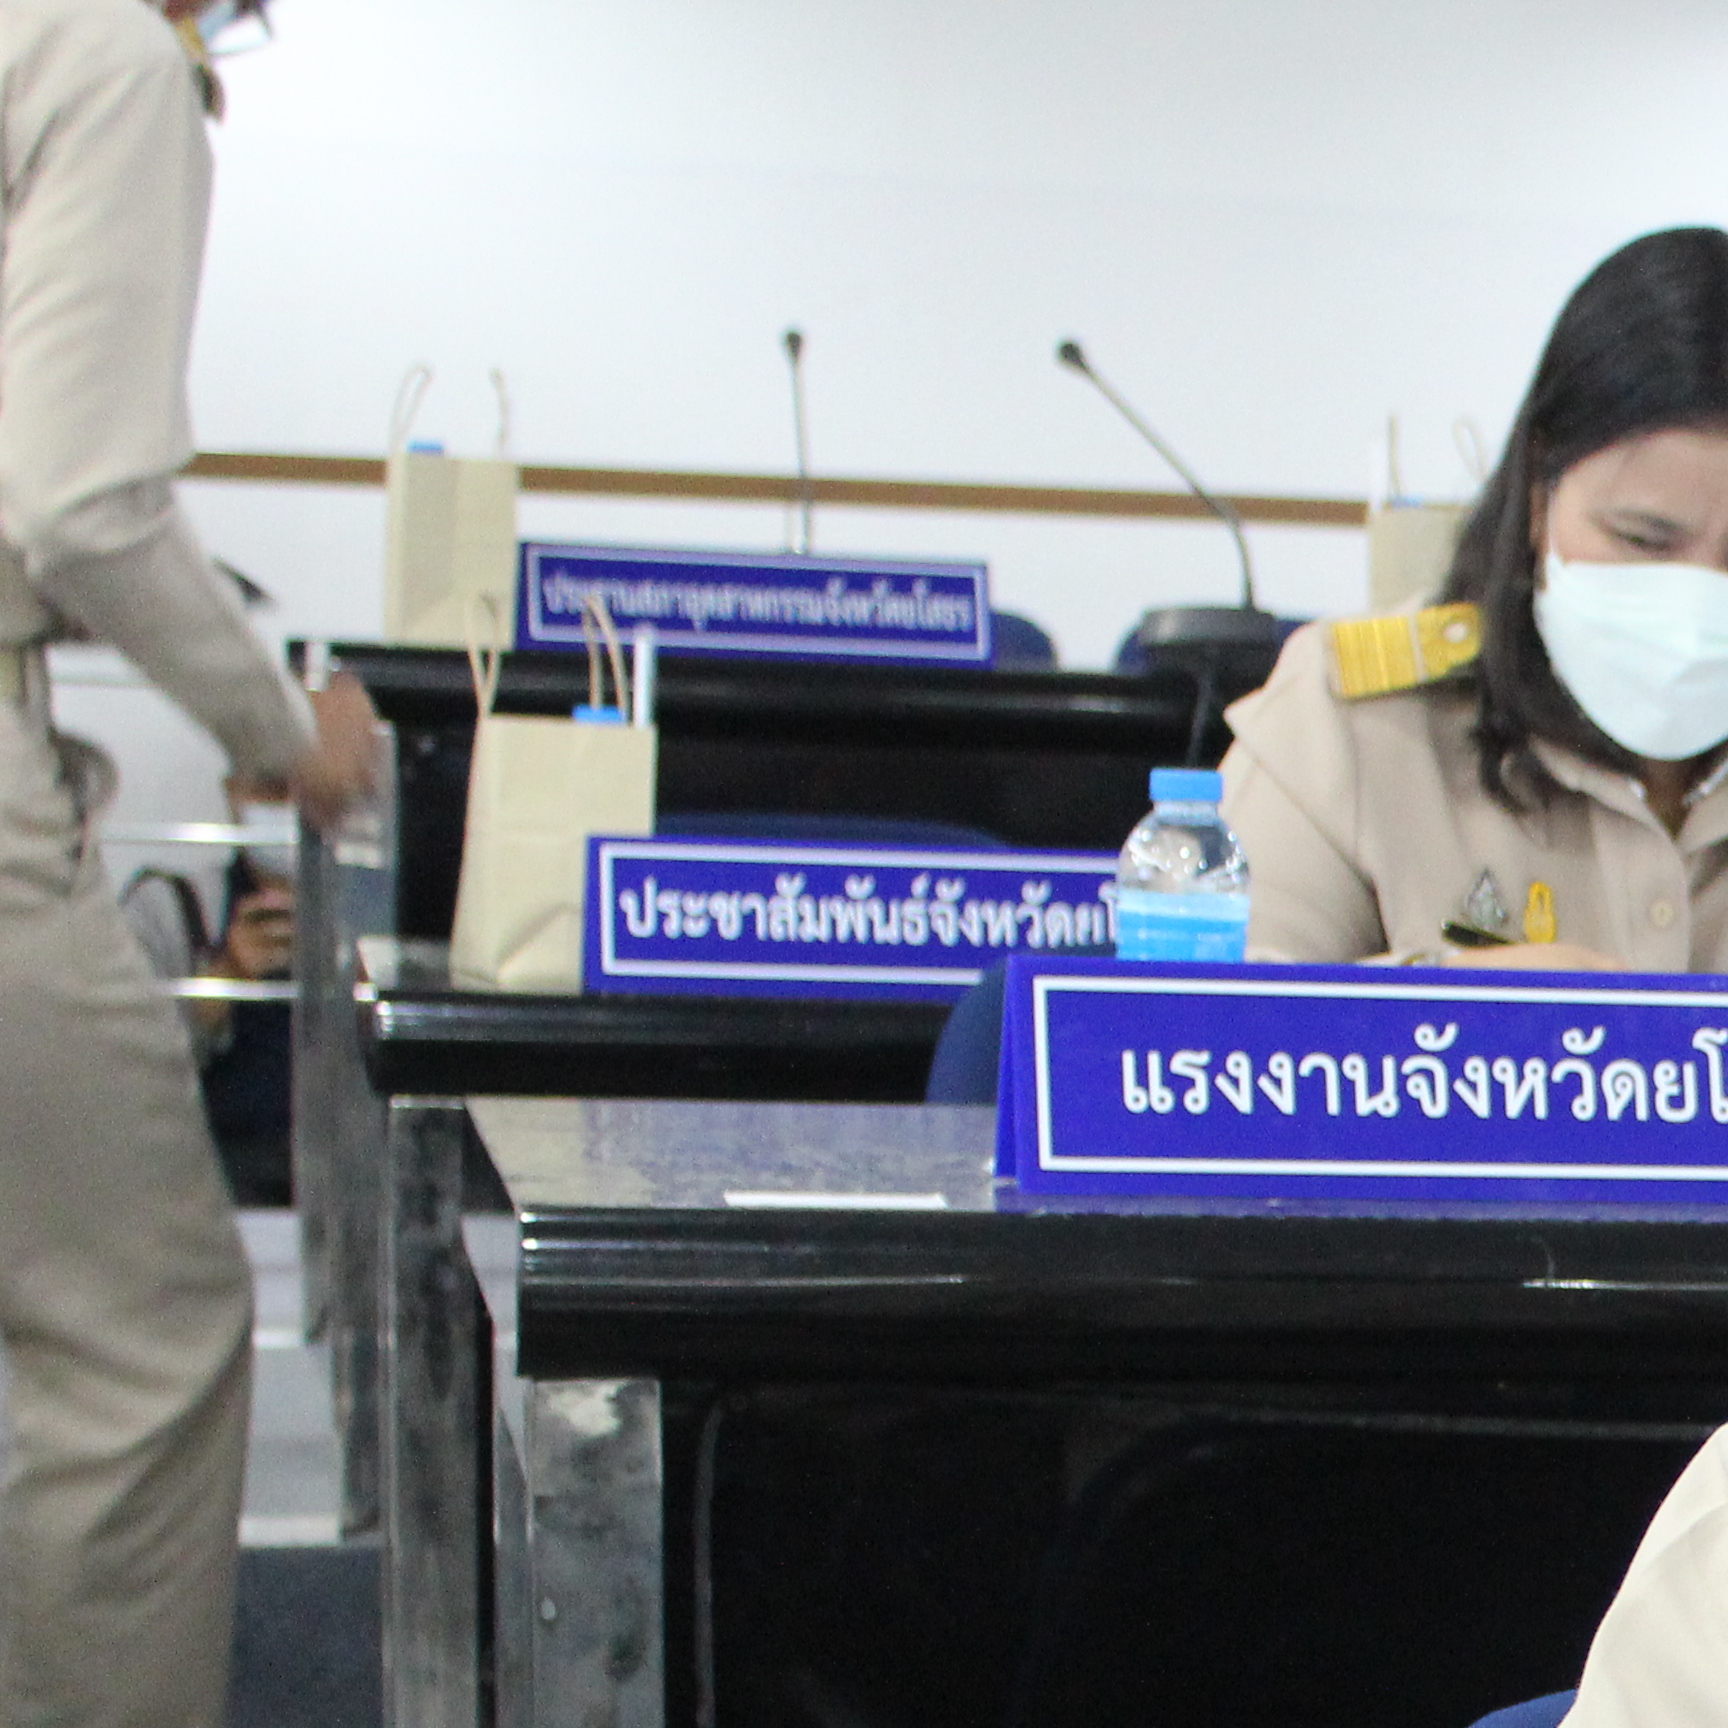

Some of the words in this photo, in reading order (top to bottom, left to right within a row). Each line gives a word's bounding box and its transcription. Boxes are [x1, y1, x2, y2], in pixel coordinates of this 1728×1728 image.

[618, 871, 1117, 948] ประชาสัมพันธ์จังหวัดยโ
